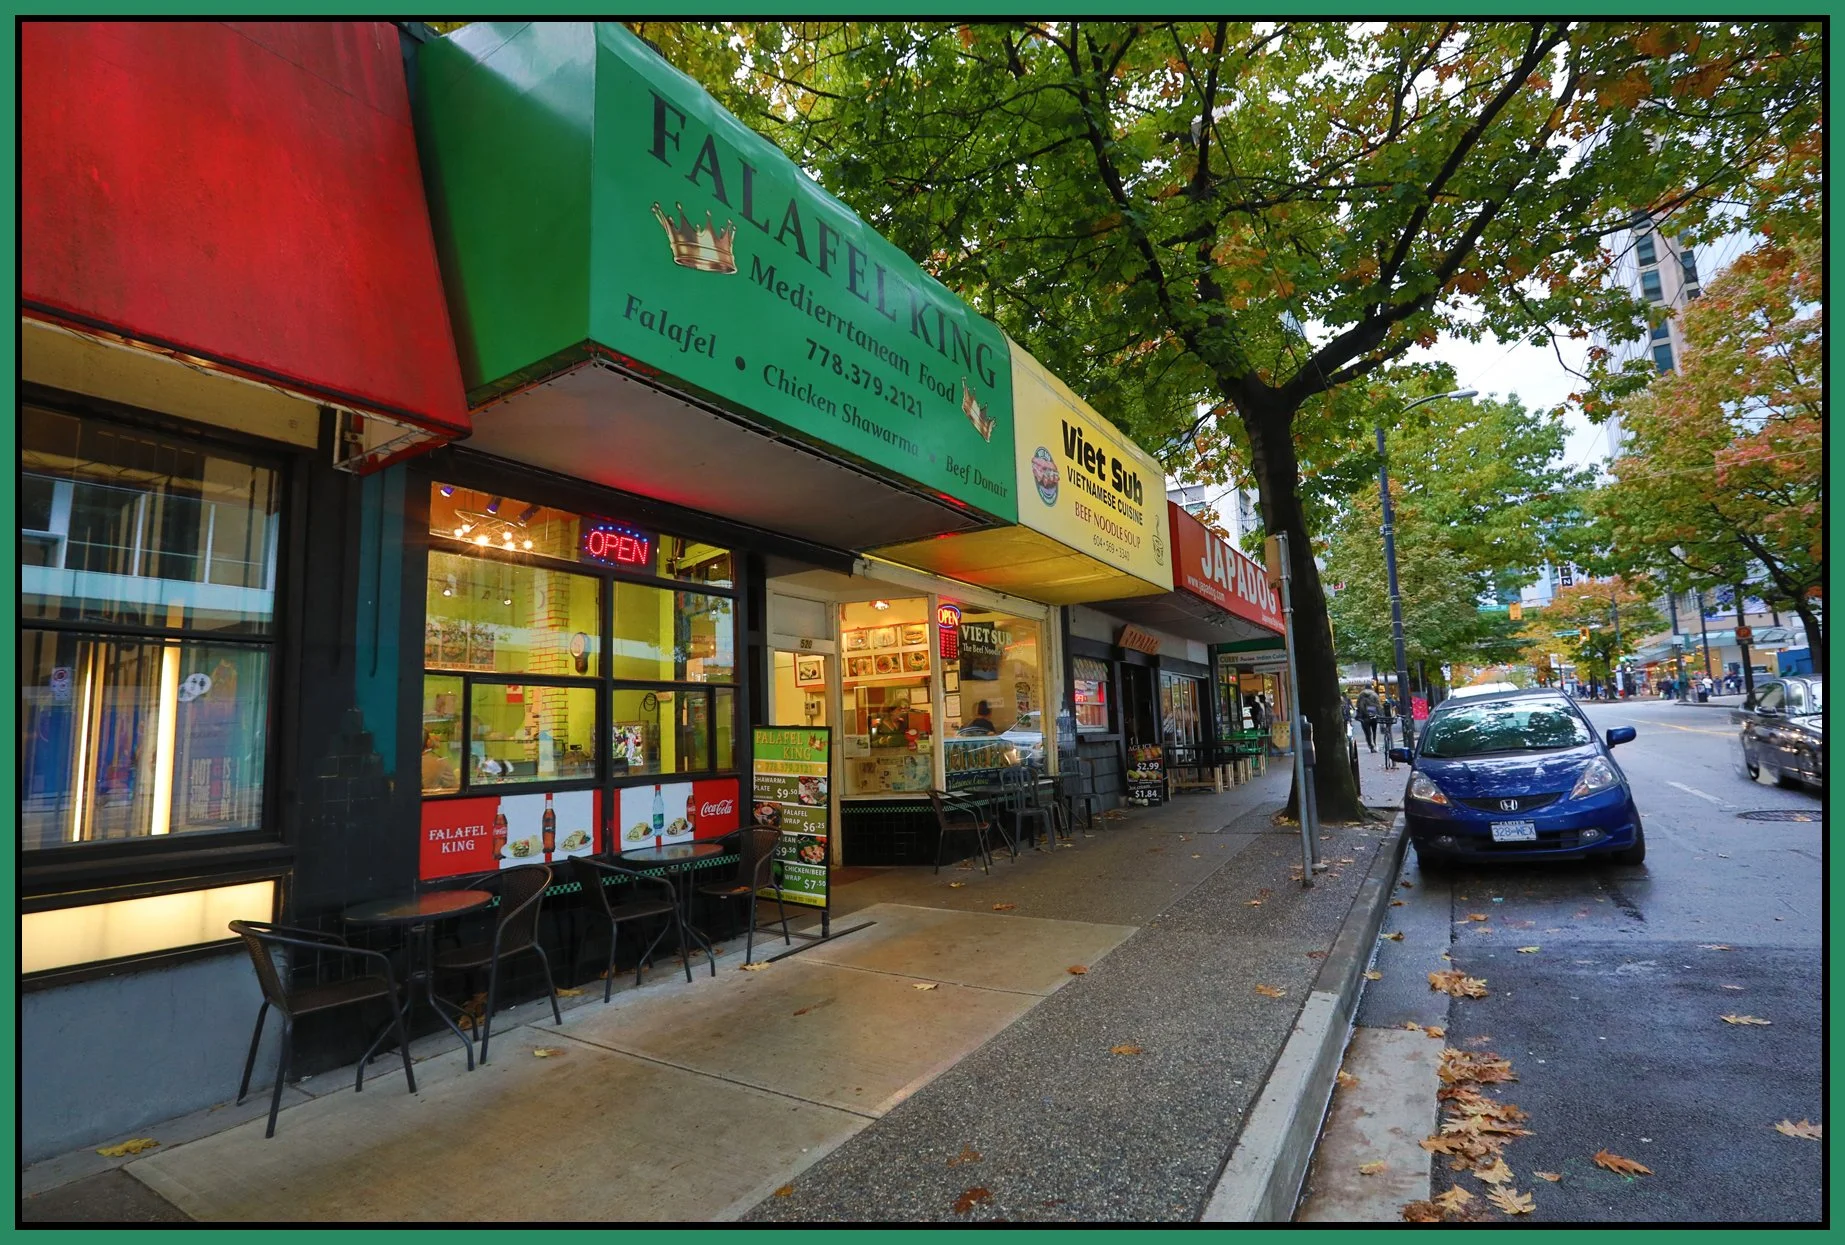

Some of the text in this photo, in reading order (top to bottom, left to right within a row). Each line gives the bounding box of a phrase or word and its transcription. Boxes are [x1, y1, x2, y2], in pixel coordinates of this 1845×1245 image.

[648, 89, 996, 389] FALAFEL KING
[748, 253, 955, 404] Medierrtanean Food
[806, 338, 923, 419] 778.379.2121
[622, 293, 1008, 498] Falafel Chicken Shawarma Beef Donair
[1061, 419, 1143, 507] Viet Sub
[1067, 465, 1117, 510] VIETNAMESE
[1117, 498, 1143, 526] CUISINE
[1075, 501, 1141, 549] BEEF NOODLE SOUP
[589, 531, 648, 564] OPEN
[1201, 529, 1276, 615] JAPADOG
[938, 608, 959, 626] OPEN
[961, 625, 1013, 646] VIET SUB
[800, 639, 813, 649] 520
[962, 643, 972, 652] The
[972, 644, 984, 654] Beef
[755, 731, 803, 745] FALAFEL
[783, 747, 811, 760] KING
[1137, 762, 1159, 770] $2.99
[776, 787, 798, 799] $9.50
[1135, 790, 1157, 798] $1.84
[783, 809, 808, 817] FALAFEL
[428, 825, 488, 841] FALAFEL
[803, 821, 825, 832] $6.25
[441, 840, 475, 854] KING
[784, 865, 827, 876] CHICKEN/BEEF
[784, 874, 802, 882] WRAP
[804, 878, 827, 890] $7.50
